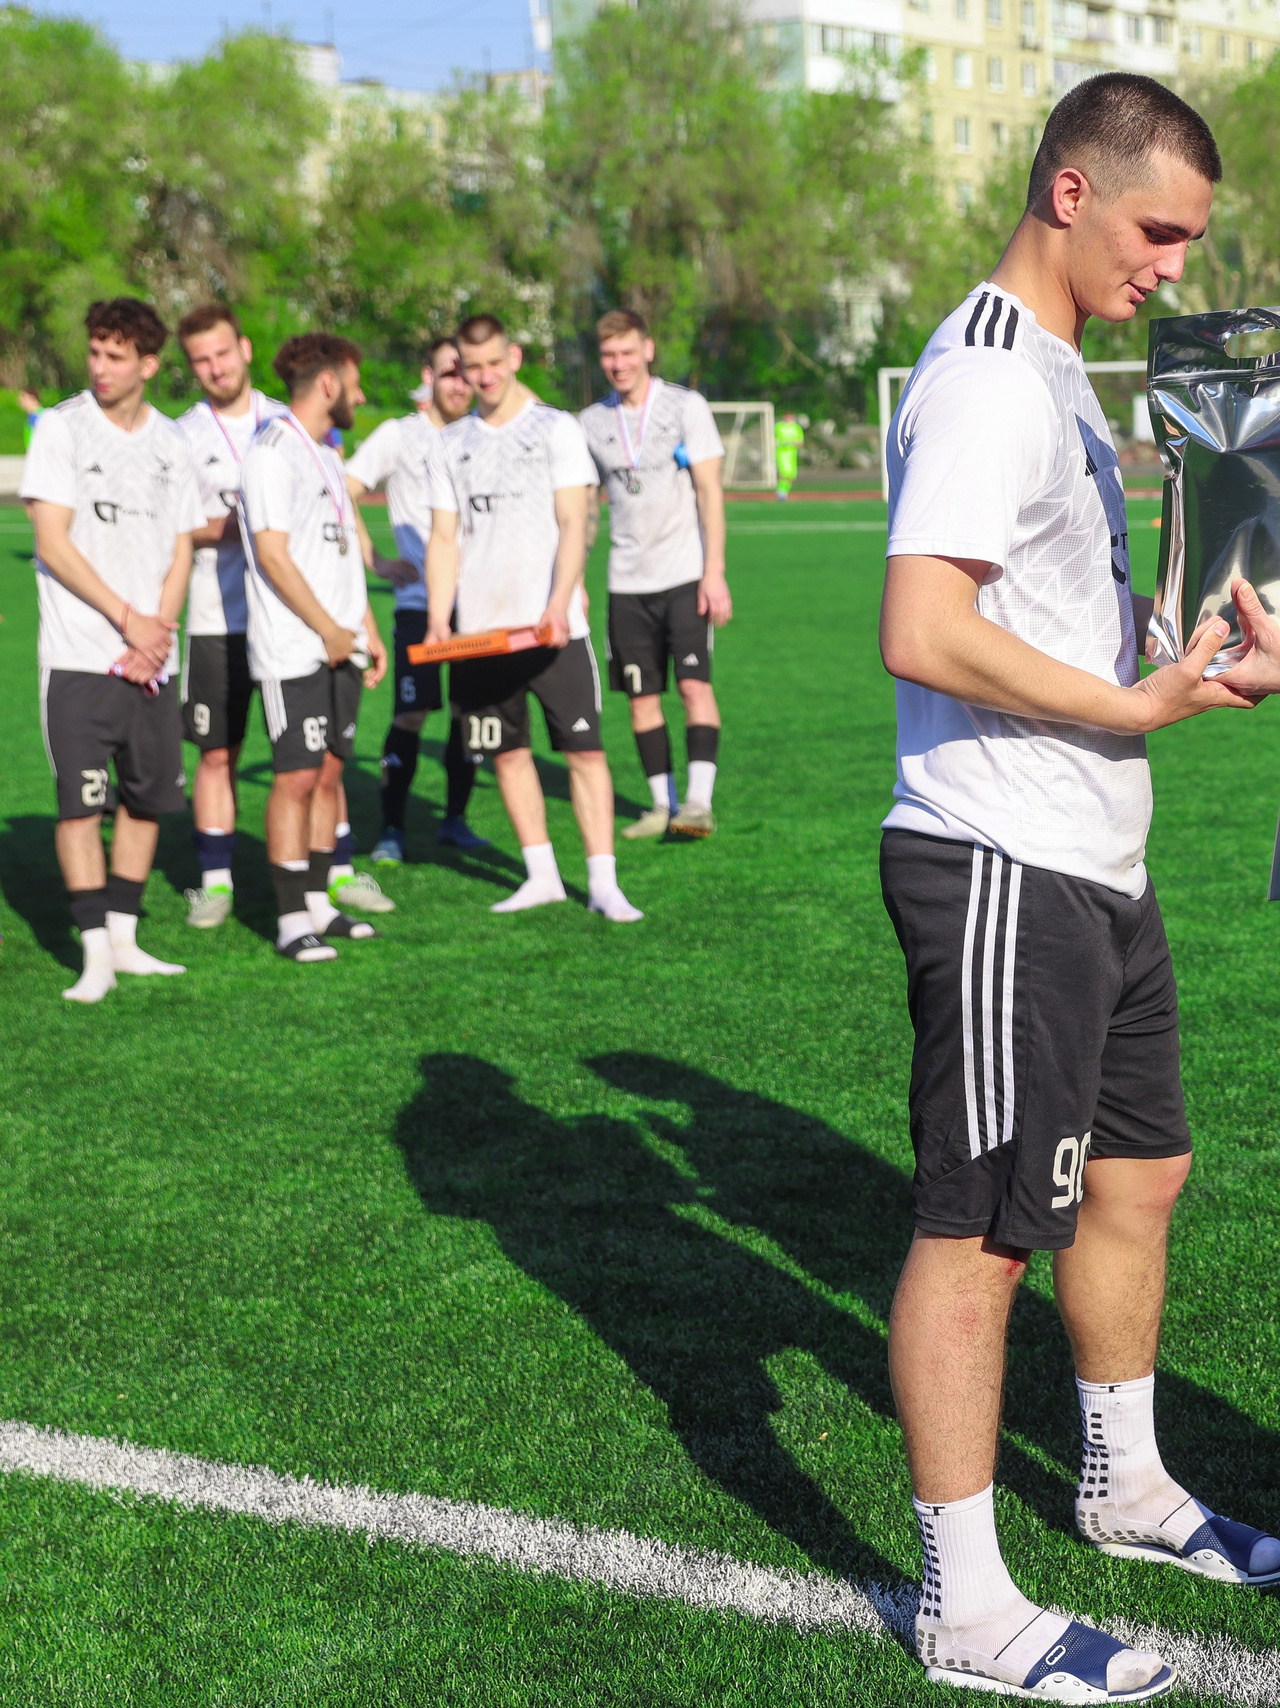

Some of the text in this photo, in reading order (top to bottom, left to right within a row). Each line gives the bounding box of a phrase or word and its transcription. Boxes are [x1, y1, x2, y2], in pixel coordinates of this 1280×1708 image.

[623, 663, 643, 694] 7
[194, 703, 211, 736] 9
[468, 715, 502, 750] 10
